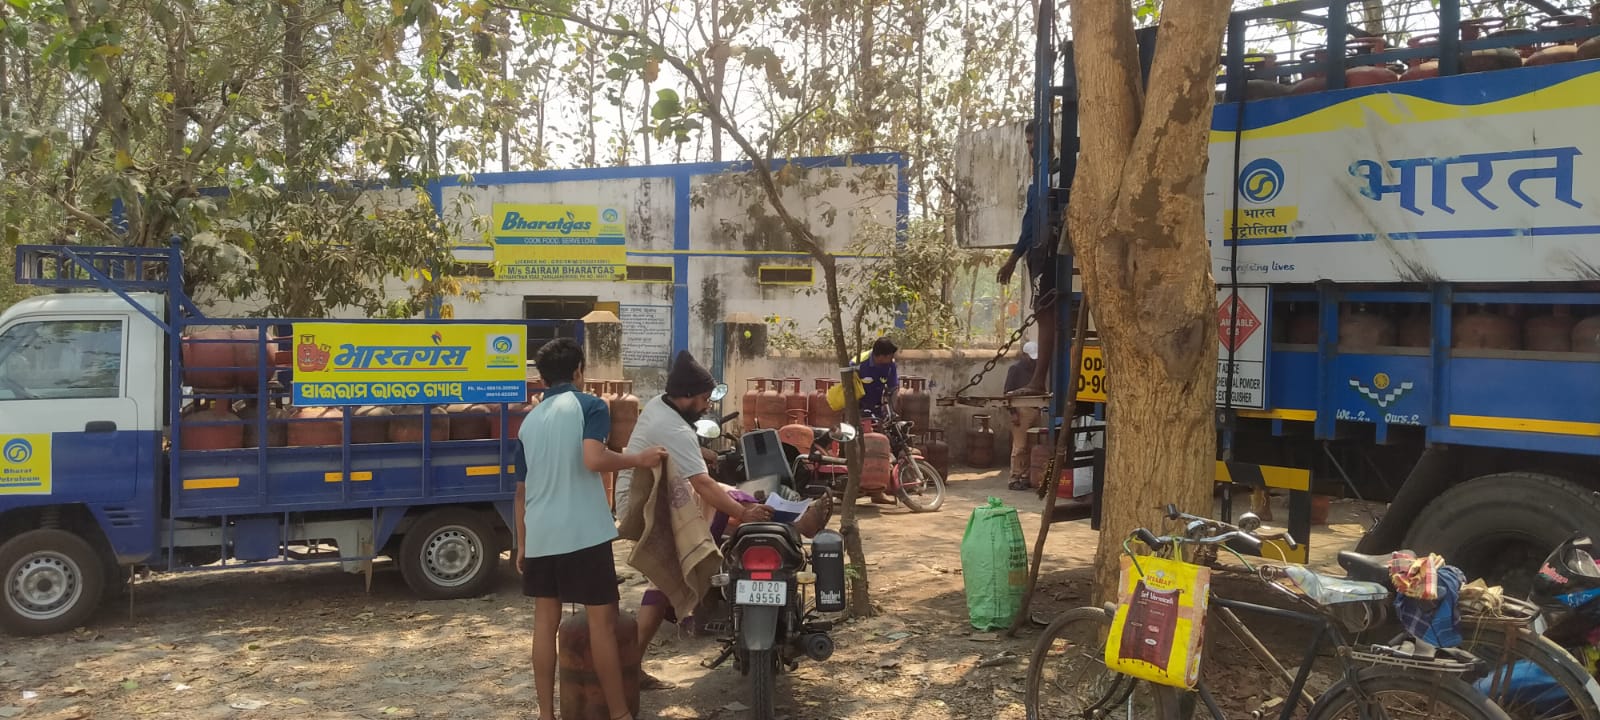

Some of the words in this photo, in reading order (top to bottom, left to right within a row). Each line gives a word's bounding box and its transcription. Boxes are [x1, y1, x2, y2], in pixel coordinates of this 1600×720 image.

[1348, 146, 1583, 216] भारत
[1243, 208, 1276, 218] भारत
[501, 211, 592, 234] Bharatgas
[1230, 222, 1288, 238] ट्रोलियम
[507, 266, 522, 274] M/s
[525, 266, 560, 275] SAIRAM
[562, 265, 615, 274] BHARATGAS
[1271, 260, 1296, 272] lives
[1226, 328, 1240, 336] GS
[1239, 377, 1261, 390] POWDER
[370, 383, 421, 399] ଭାରତ
[751, 582, 765, 592] OD
[767, 582, 780, 592] 20
[749, 593, 781, 604] A9556
